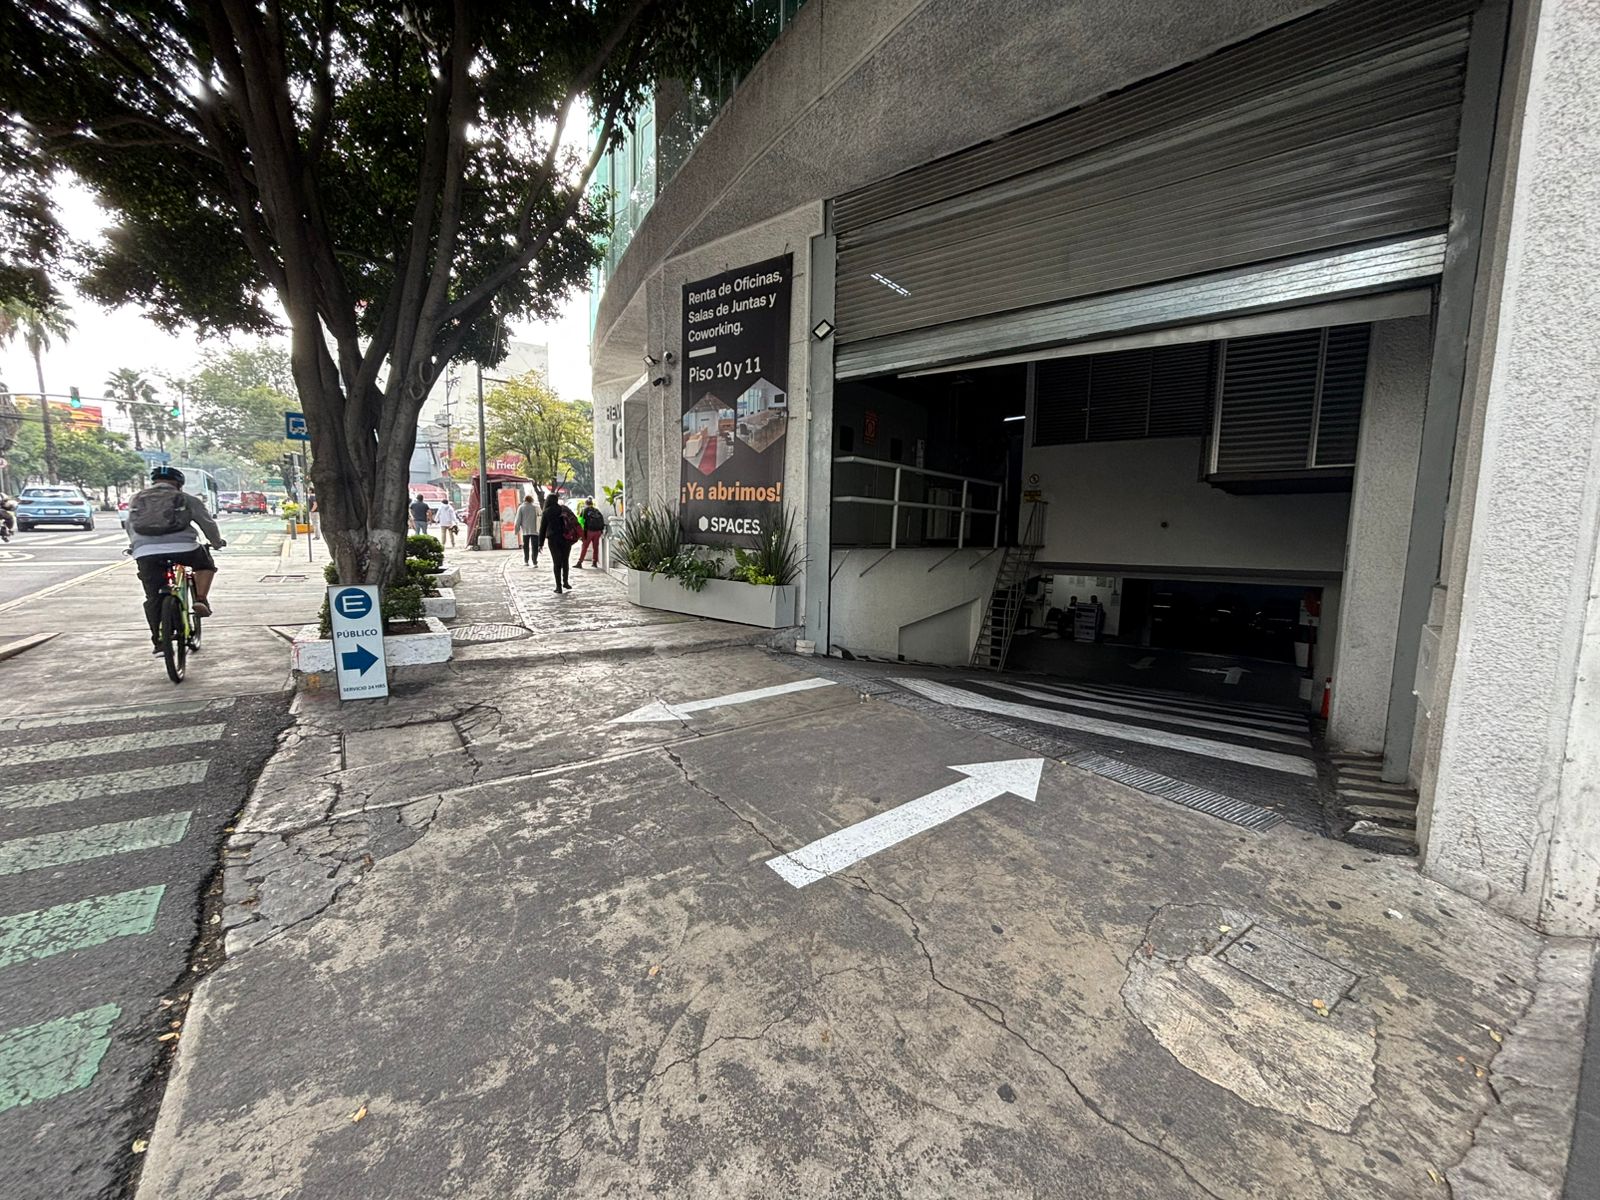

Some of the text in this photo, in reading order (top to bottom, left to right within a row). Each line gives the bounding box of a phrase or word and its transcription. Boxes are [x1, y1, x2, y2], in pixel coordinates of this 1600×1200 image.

[688, 271, 783, 305] Renta de Oficinas,
[688, 293, 777, 324] Salas de Juntas y
[688, 321, 744, 342] Coworking.
[689, 356, 761, 383] Piso 10 y 11
[496, 459, 516, 470] Fried
[681, 481, 781, 504] ¡Ya abrimos!
[336, 628, 378, 639] PÚBLICO
